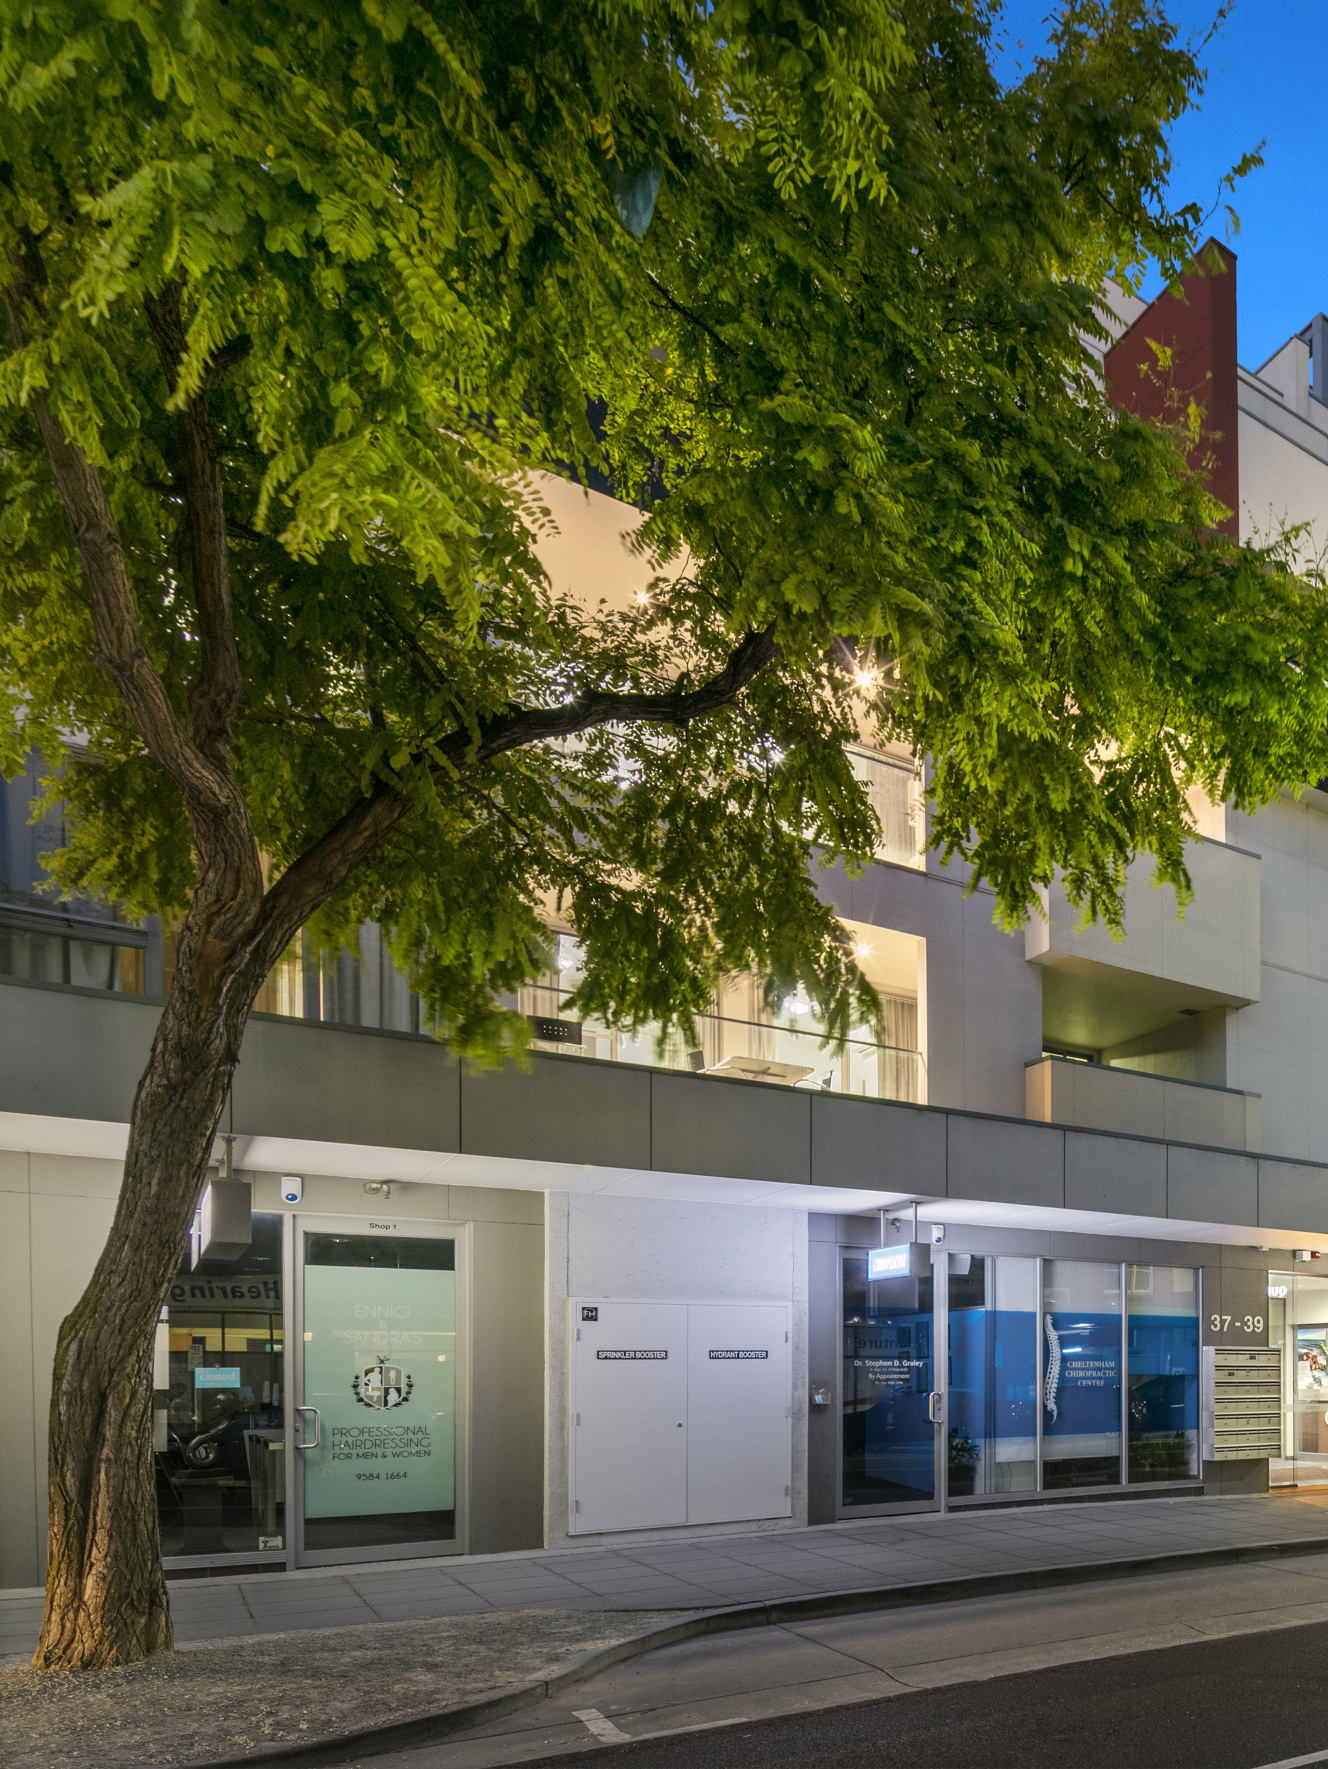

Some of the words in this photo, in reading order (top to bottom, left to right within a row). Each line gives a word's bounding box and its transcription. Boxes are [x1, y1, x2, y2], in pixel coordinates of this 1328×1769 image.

[369, 1222, 391, 1230] Shop
[355, 1304, 410, 1319] ENNIO
[584, 1310, 596, 1318] FH
[378, 1320, 387, 1329] &
[343, 1330, 423, 1344] SANDRA'S
[598, 1351, 635, 1359] SPRINKLER
[636, 1351, 667, 1359] BOOSTER
[865, 1360, 893, 1368] Stephen
[902, 1360, 924, 1368] Graley
[200, 1371, 236, 1381] closed
[332, 1425, 431, 1438] PROFESSIONAL
[332, 1437, 431, 1450] HAIRDRESSING
[332, 1452, 353, 1460] FOR
[356, 1451, 378, 1460] MEN
[381, 1451, 388, 1459] &
[392, 1450, 431, 1458] WOMEN
[356, 1472, 380, 1480] 9584
[385, 1471, 407, 1480] 1664
